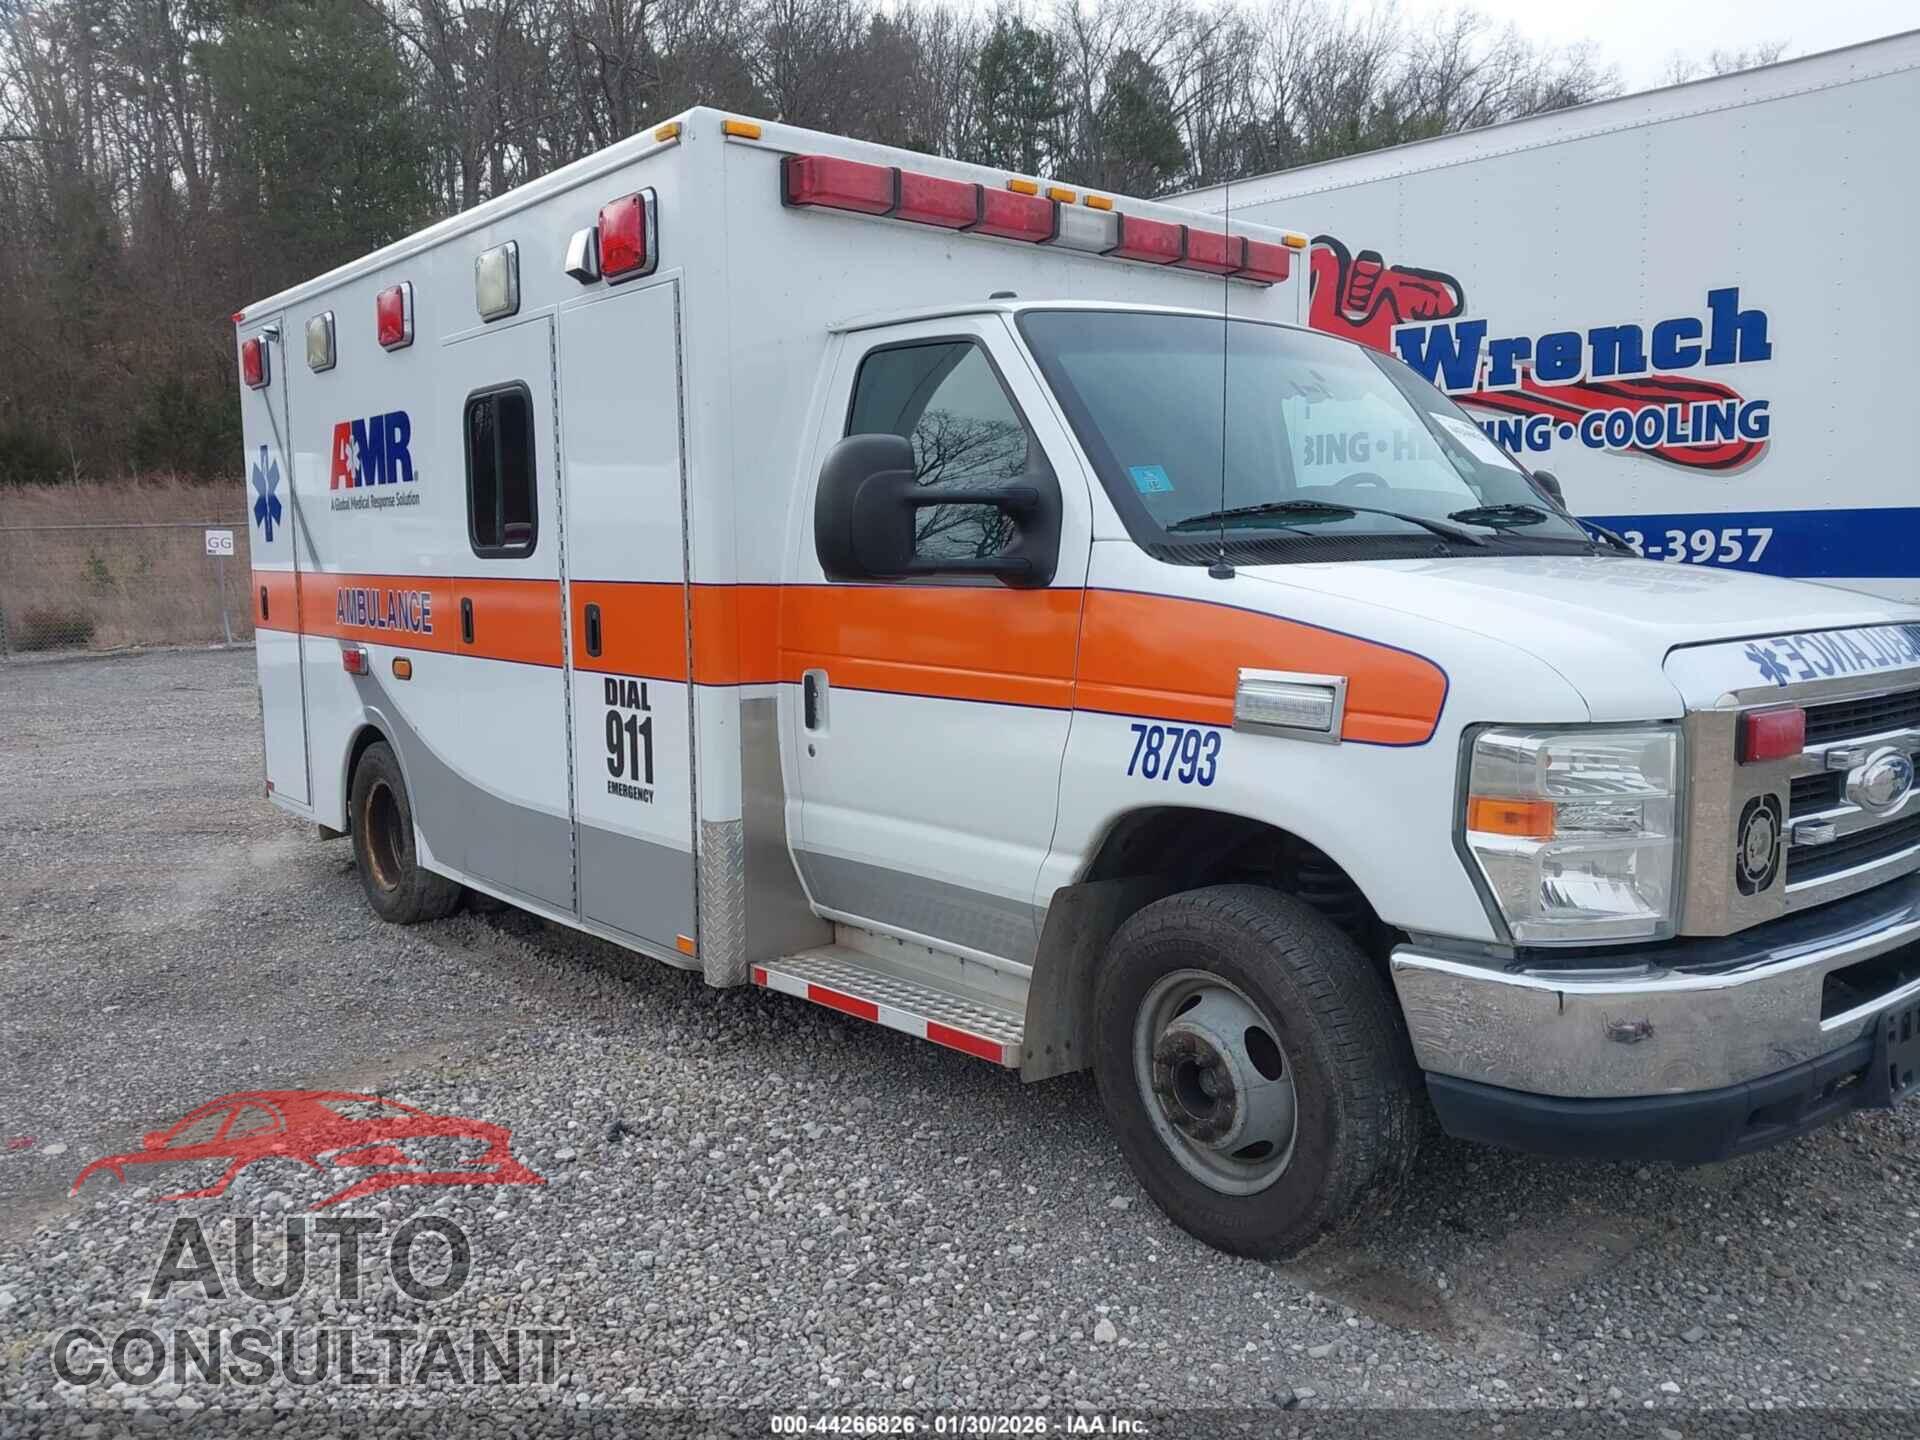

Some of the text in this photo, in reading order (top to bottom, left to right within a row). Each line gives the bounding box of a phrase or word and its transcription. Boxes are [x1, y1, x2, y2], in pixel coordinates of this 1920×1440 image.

[1396, 287, 1772, 390] Wrench
[1580, 400, 1771, 449] COOLING
[330, 410, 414, 490] AMR
[396, 490, 420, 506] Solution
[207, 536, 232, 549] GG
[1597, 528, 1774, 563] 3-3957
[336, 587, 433, 635] AMBULANCE
[604, 677, 652, 711] DIAL
[606, 709, 654, 784] 911
[1127, 723, 1222, 787] 78793
[607, 780, 654, 804] EMERGENCY
